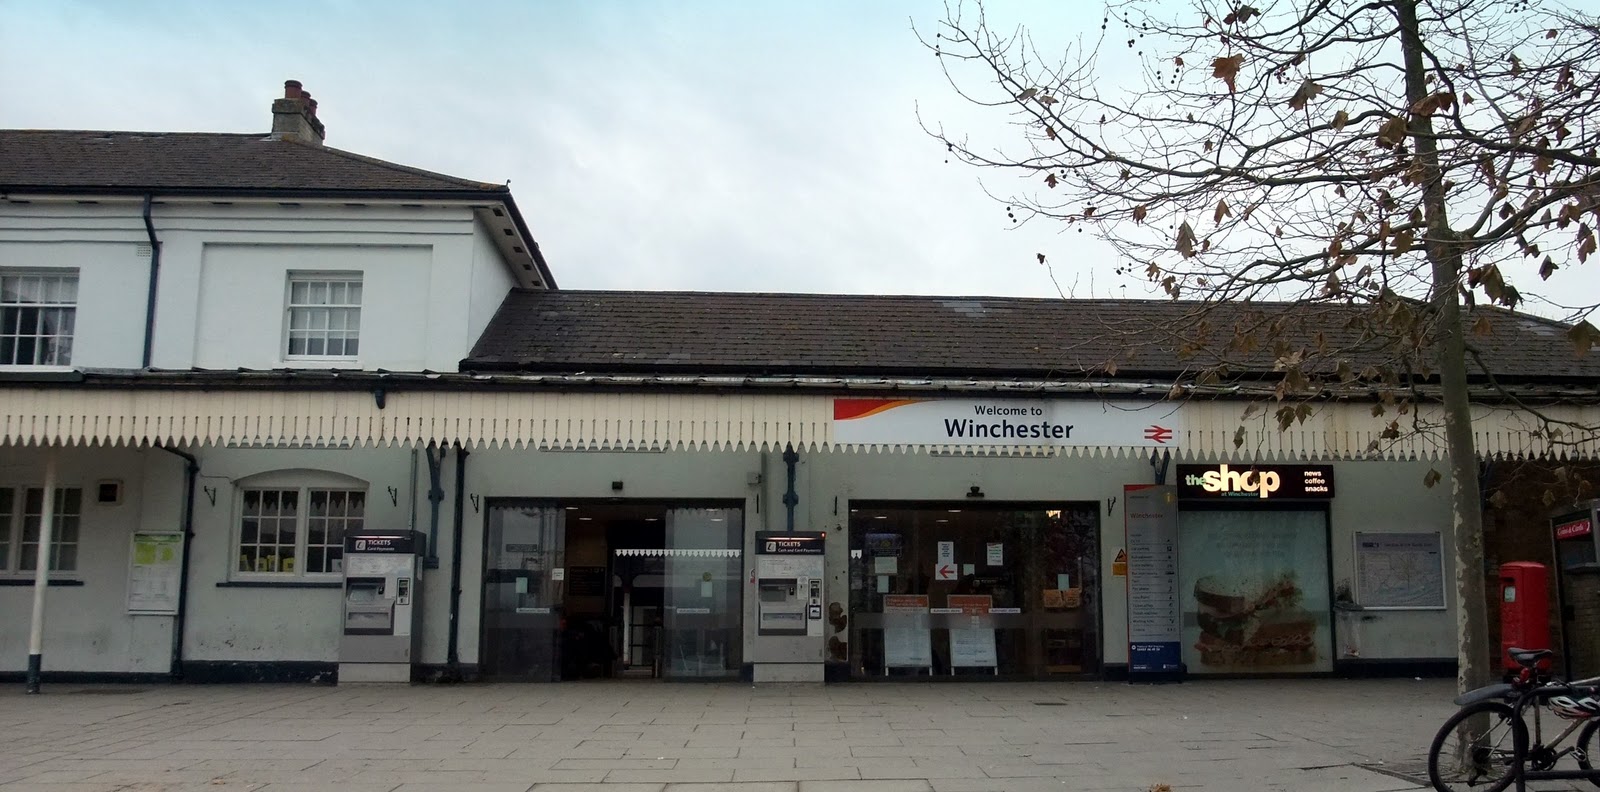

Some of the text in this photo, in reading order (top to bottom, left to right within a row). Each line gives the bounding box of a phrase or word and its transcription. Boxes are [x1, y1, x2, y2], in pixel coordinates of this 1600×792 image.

[974, 405, 1042, 416] Welcome to
[944, 418, 1074, 439] Winchester
[1185, 464, 1280, 498] the shop
[1304, 485, 1328, 493] snacks
